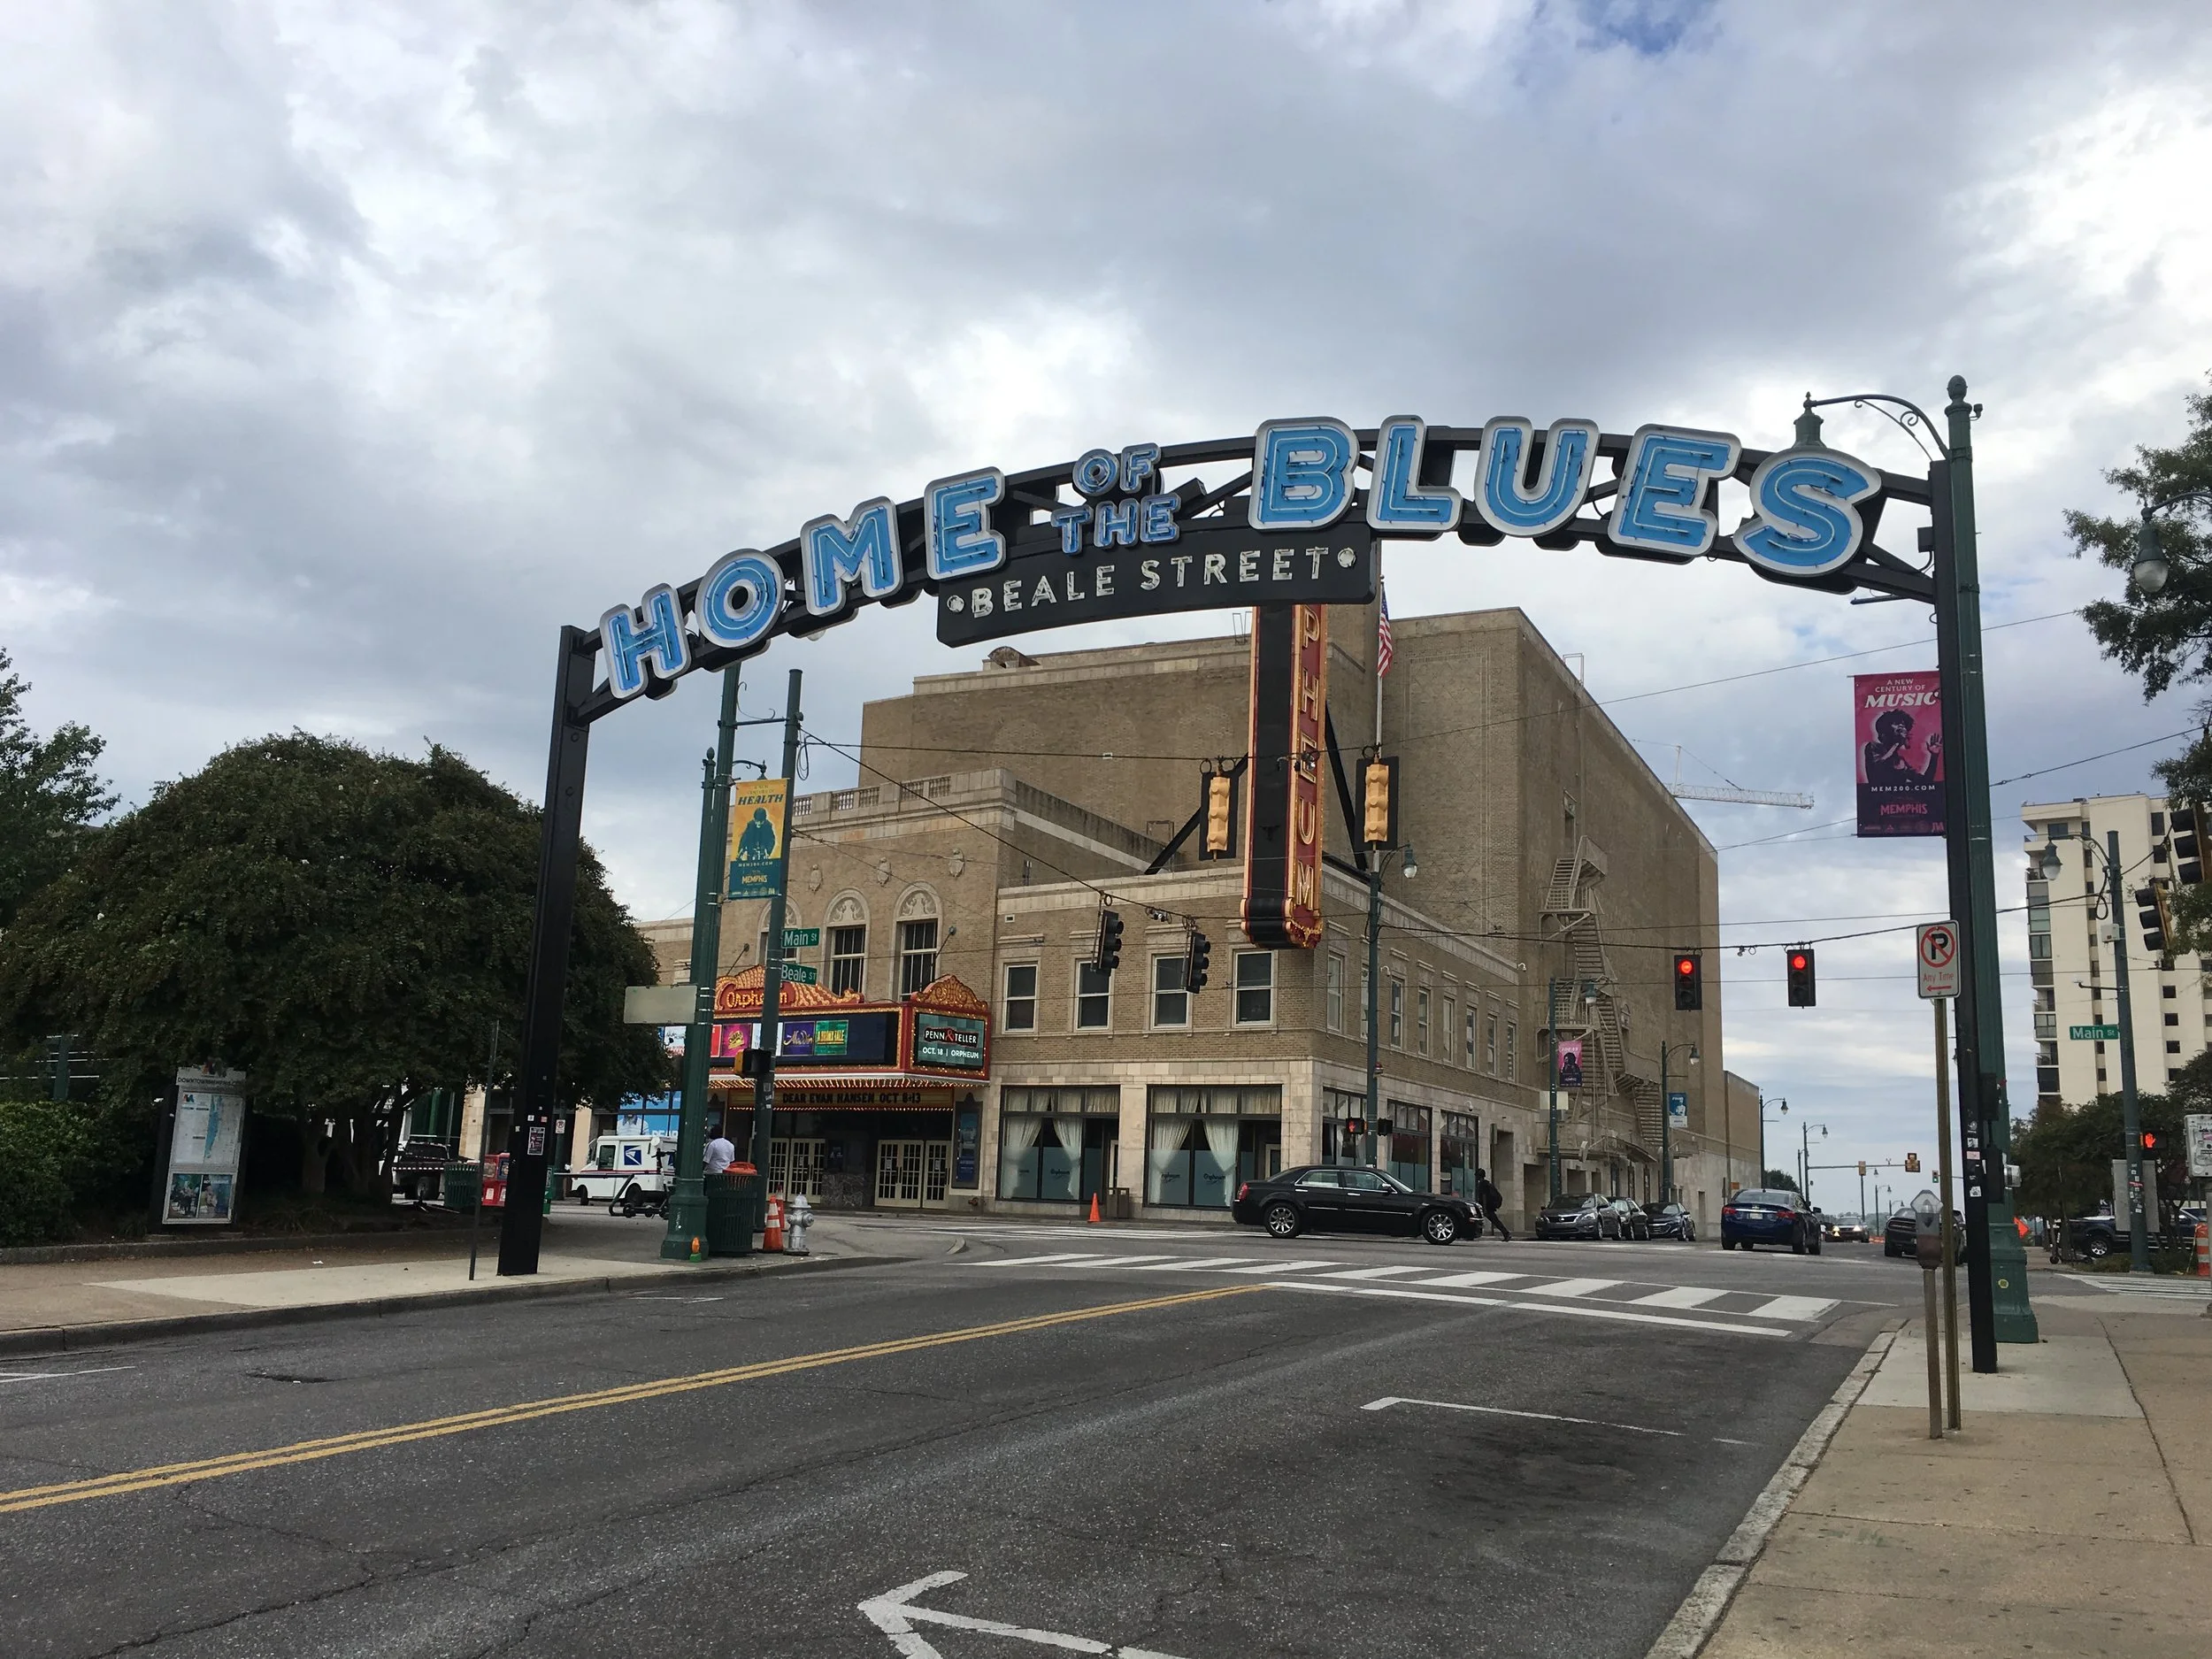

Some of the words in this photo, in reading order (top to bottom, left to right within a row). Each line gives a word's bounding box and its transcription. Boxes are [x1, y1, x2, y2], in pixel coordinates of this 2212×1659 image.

[1072, 442, 1161, 496] OF
[1248, 416, 1881, 577] BLUES
[1050, 493, 1180, 554] THE
[600, 466, 1006, 699] HOME
[972, 565, 1115, 618] BEALE
[1141, 546, 1329, 590] STREET
[1865, 691, 1939, 708] MUSIC
[738, 794, 784, 805] HEALTH
[1880, 803, 1928, 816] MEMPHIS
[784, 930, 809, 947] Main
[781, 964, 807, 982] Beale
[1923, 973, 1936, 983] Any
[1939, 972, 1954, 981] Time
[926, 1031, 945, 1040] PENN
[955, 1033, 977, 1044] TELLER
[2072, 1026, 2104, 1039] Main
[950, 1049, 979, 1059] ORPHEUM
[782, 1093, 806, 1103] DEAR
[810, 1093, 833, 1103] EVAN
[837, 1093, 874, 1103] HANSEN
[879, 1092, 899, 1103] OCT
